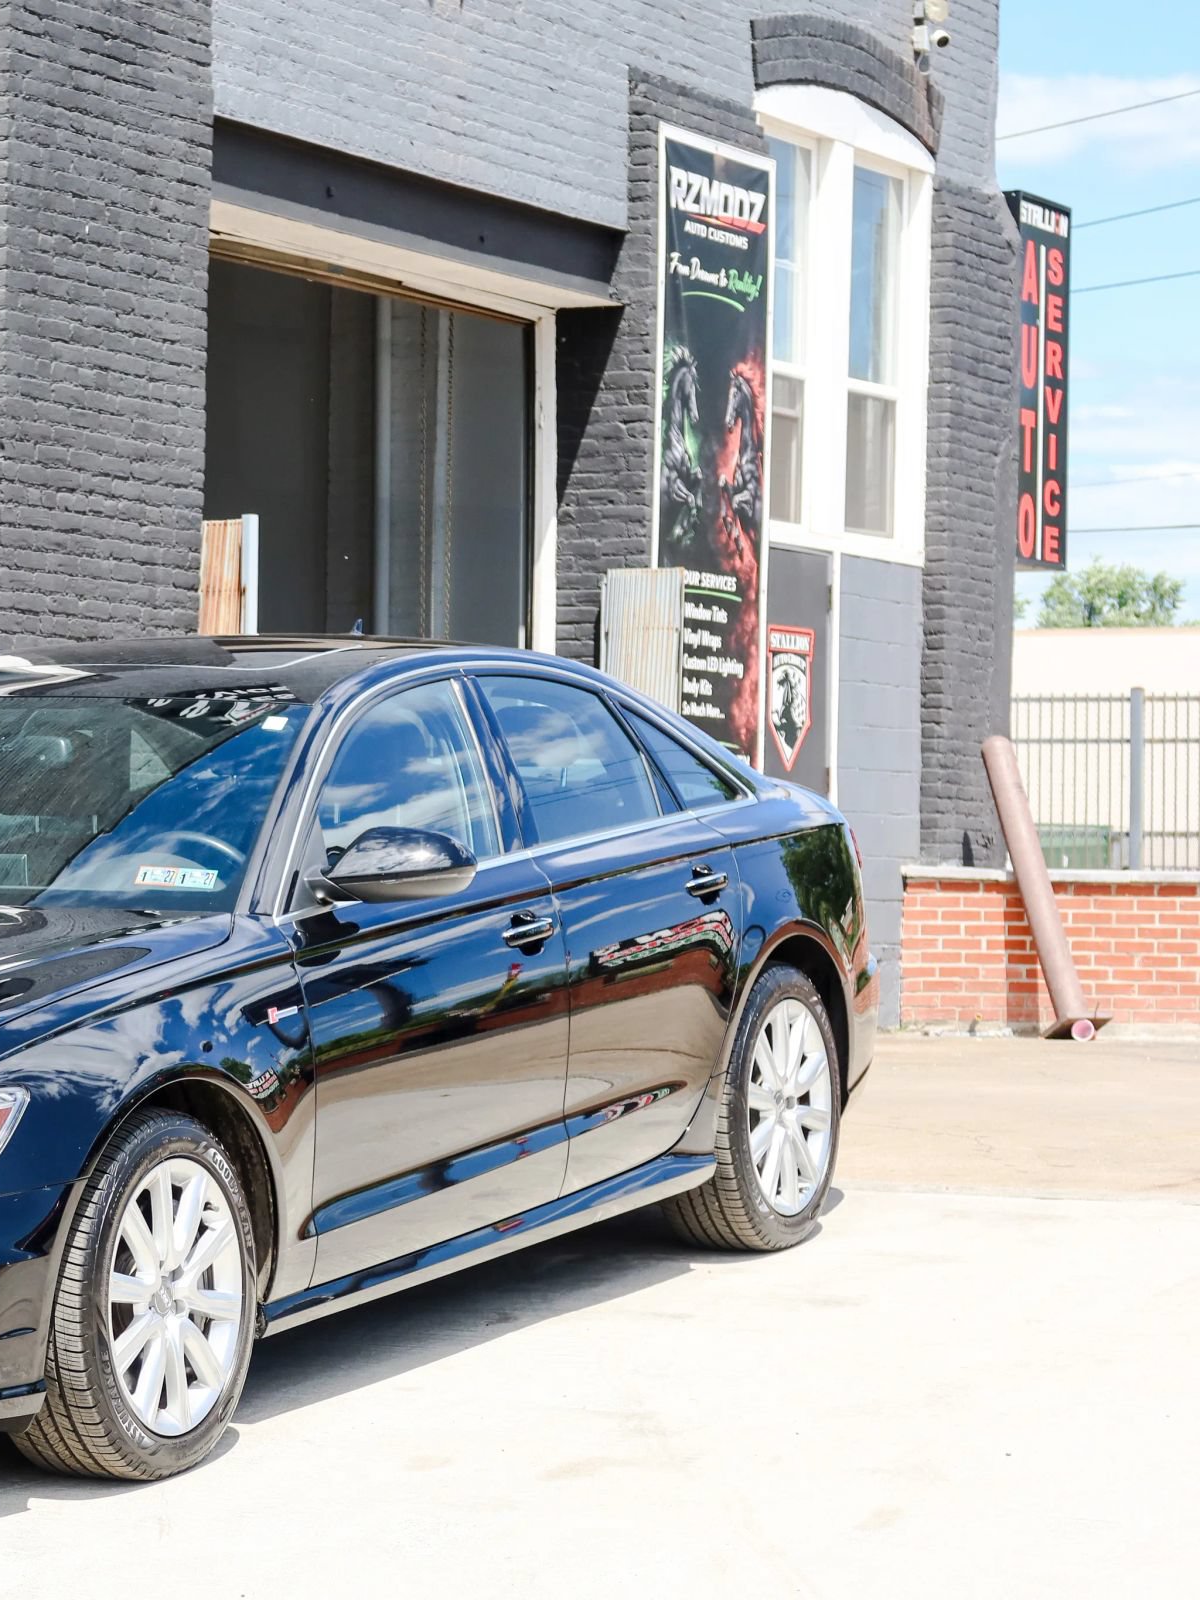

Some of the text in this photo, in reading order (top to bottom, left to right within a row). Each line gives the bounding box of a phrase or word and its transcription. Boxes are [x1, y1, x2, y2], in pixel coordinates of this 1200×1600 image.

[669, 165, 767, 230] RZMODZ
[1020, 199, 1069, 238] STALLION
[683, 219, 749, 250] AUTO CUSTOMS
[1018, 240, 1038, 558] AUTO
[1042, 248, 1065, 563] SERVICE
[700, 572, 737, 592] SERVICES
[684, 601, 728, 624] Window Tints
[683, 627, 722, 652] Vinyl Wraps
[683, 653, 743, 679] Custom LED Lighting
[683, 676, 712, 698] Body Kits
[682, 700, 690, 715] So
[141, 870, 175, 883] 1 27
[180, 872, 215, 886] 1 27
